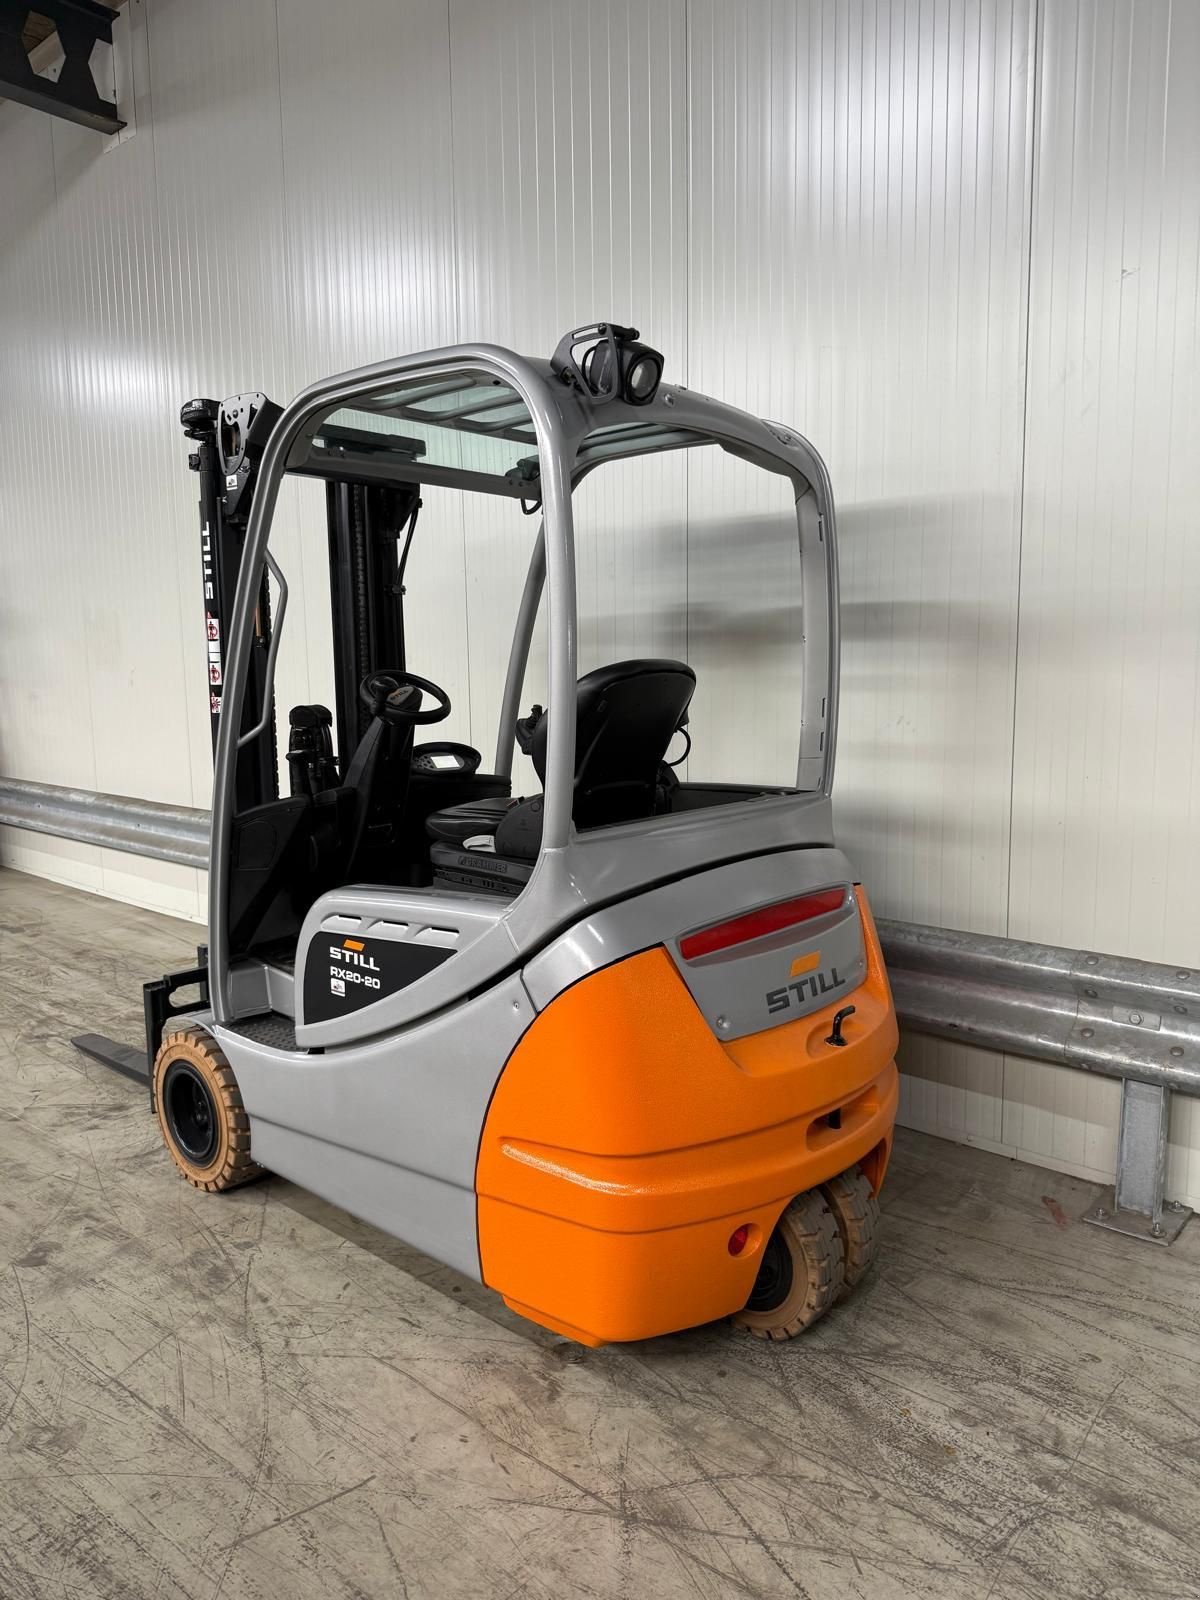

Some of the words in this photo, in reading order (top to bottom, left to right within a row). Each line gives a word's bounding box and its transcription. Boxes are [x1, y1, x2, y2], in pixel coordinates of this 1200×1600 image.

[202, 521, 213, 599] STILL
[329, 947, 380, 971] STILL
[330, 966, 380, 989] RX20-20
[766, 968, 845, 1014] STILL
